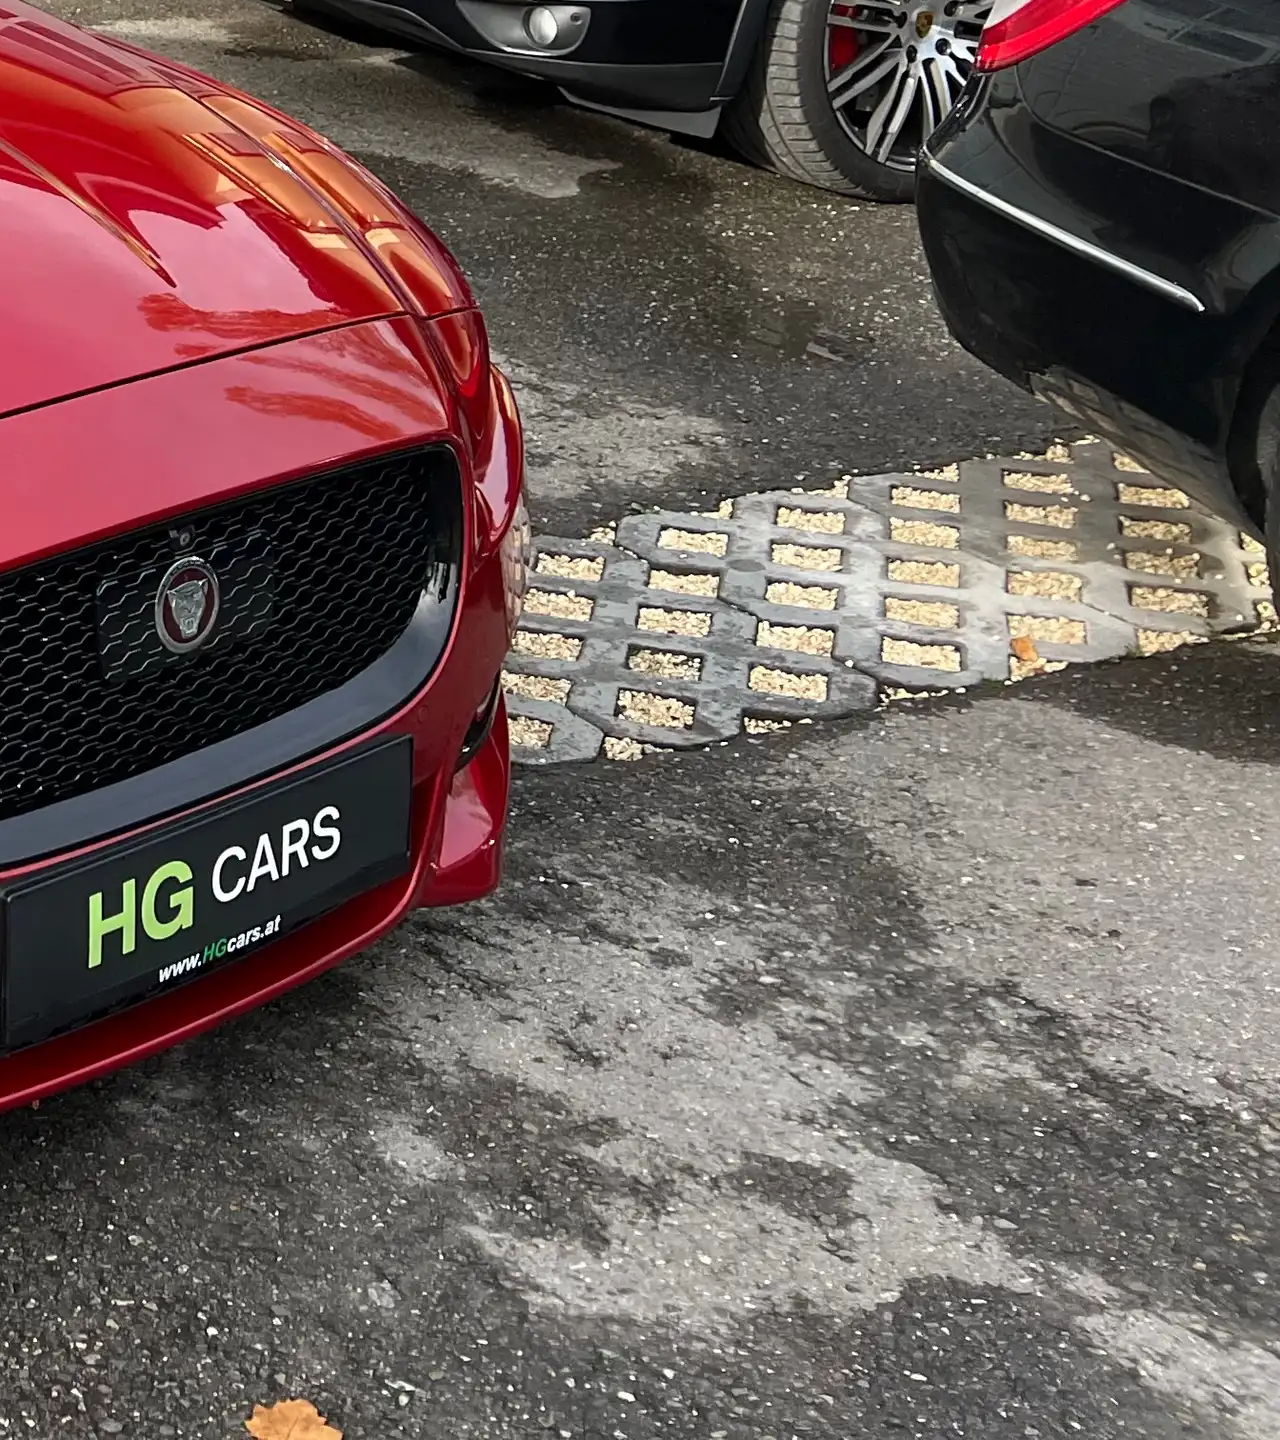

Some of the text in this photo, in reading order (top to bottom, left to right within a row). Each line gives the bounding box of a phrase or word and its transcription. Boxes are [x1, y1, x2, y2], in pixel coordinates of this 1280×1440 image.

[87, 805, 342, 969] HG CARS
[158, 913, 282, 984] www.HGcars.at
